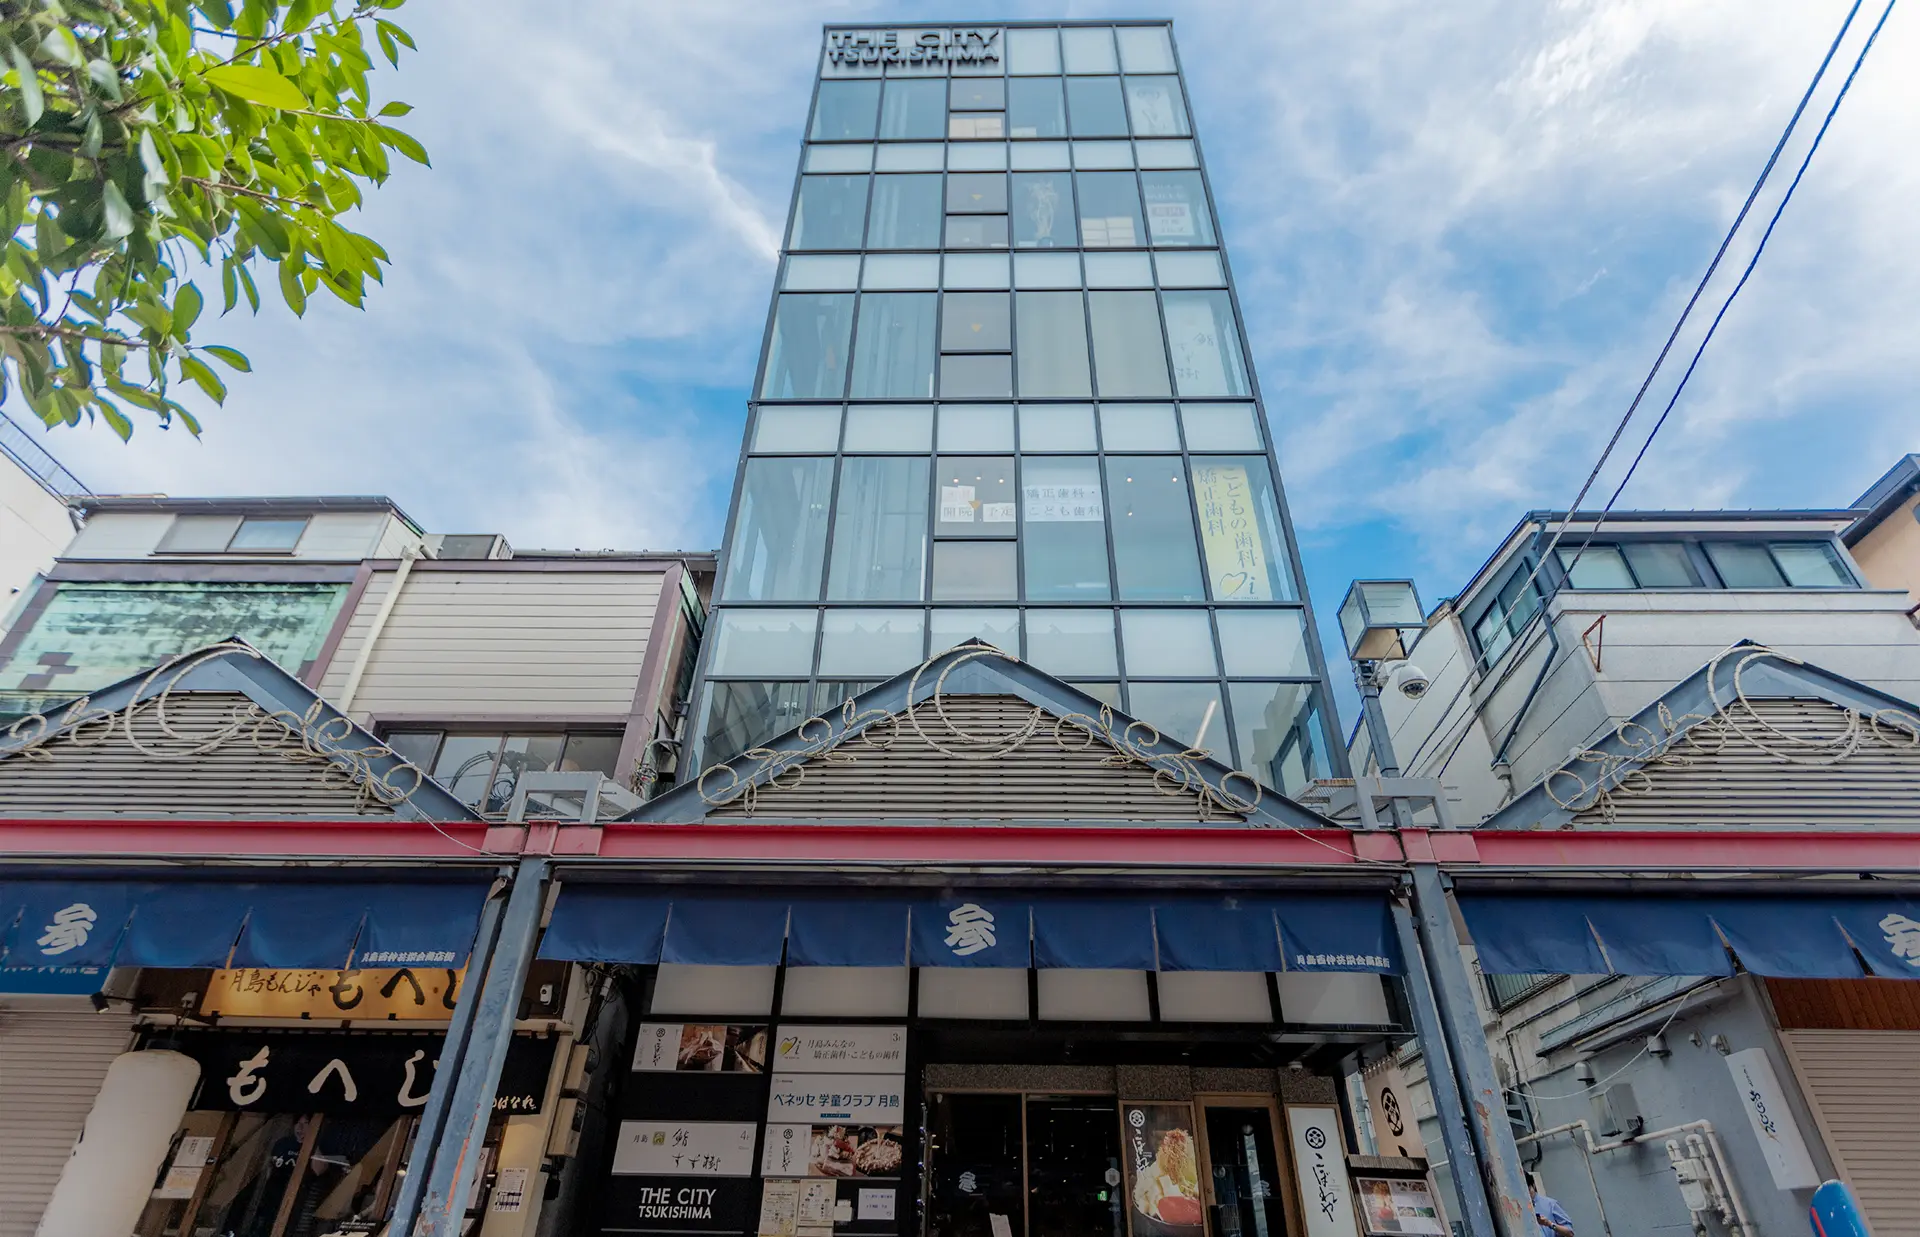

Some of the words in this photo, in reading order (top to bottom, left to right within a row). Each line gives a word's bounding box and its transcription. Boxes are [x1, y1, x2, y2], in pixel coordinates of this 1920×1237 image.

[831, 30, 899, 48] THE
[915, 29, 1000, 47] CITY
[828, 46, 1000, 66] TSUKISHIMA
[640, 1187, 671, 1204] THE
[677, 1187, 717, 1205] CITY
[638, 1205, 712, 1219] TSUKISHIMA
